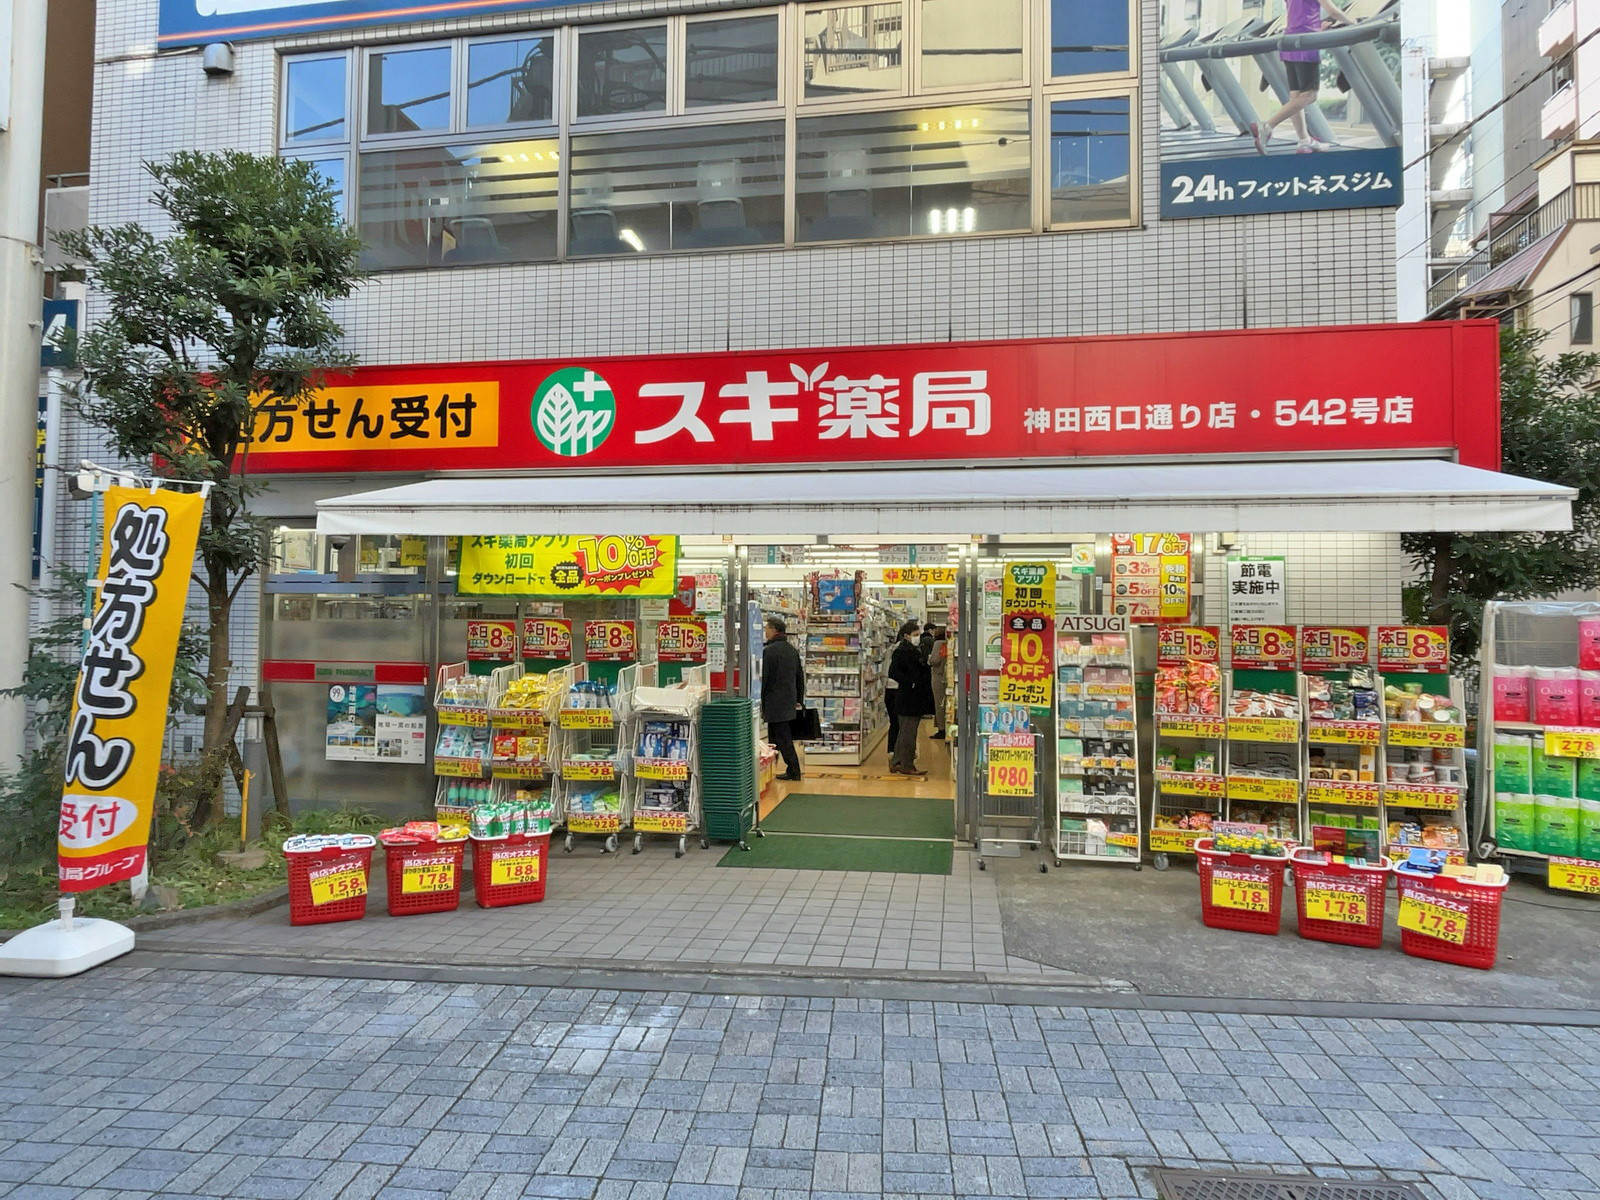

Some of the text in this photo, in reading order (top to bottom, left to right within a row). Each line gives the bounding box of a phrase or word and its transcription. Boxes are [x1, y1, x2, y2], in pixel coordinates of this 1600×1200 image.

[1171, 170, 1393, 204] 24h フィットネスジム
[634, 360, 992, 445] スギ薬局
[1023, 396, 1414, 433] 神田西口通り店・542号店
[1162, 542, 1187, 554] OFF
[504, 552, 535, 570] 初回
[554, 570, 580, 584] 全品
[588, 568, 653, 585] クーポンプレゼント
[901, 568, 956, 582] 処方せん
[1240, 563, 1272, 578] 節電
[472, 572, 546, 586] ダウンロードで
[1017, 575, 1041, 584] アプリ
[1015, 587, 1042, 599] 初回
[1232, 580, 1280, 595] 実施中
[468, 623, 488, 638] 本日
[525, 621, 545, 636] 本日
[1012, 617, 1043, 630] 全品
[1061, 616, 1126, 632] ATSUGI
[586, 624, 607, 639] 本日
[660, 624, 680, 639] 本日
[1160, 630, 1185, 645] 本日
[1232, 628, 1260, 645] 本日
[1304, 631, 1331, 646] 本日
[1380, 631, 1408, 646] 本日
[66, 502, 170, 790] 処方せん
[1007, 663, 1046, 677] OFF
[1007, 683, 1045, 695] クーポン
[1003, 692, 1049, 705] プレゼント
[1561, 740, 1596, 751] 278
[990, 766, 1028, 787] 1980
[404, 857, 454, 867] 当店オススメ
[492, 850, 539, 860] 当店オススメ
[309, 860, 363, 880] 当店オススメ
[1213, 870, 1269, 883] 当店オススメ
[1306, 880, 1366, 893] 当店オススメ
[1566, 872, 1600, 887] 278
[1246, 902, 1264, 910] 127
[1403, 889, 1469, 912] 当店オススメ
[1342, 913, 1362, 923] 192
[1436, 929, 1458, 942] 192
